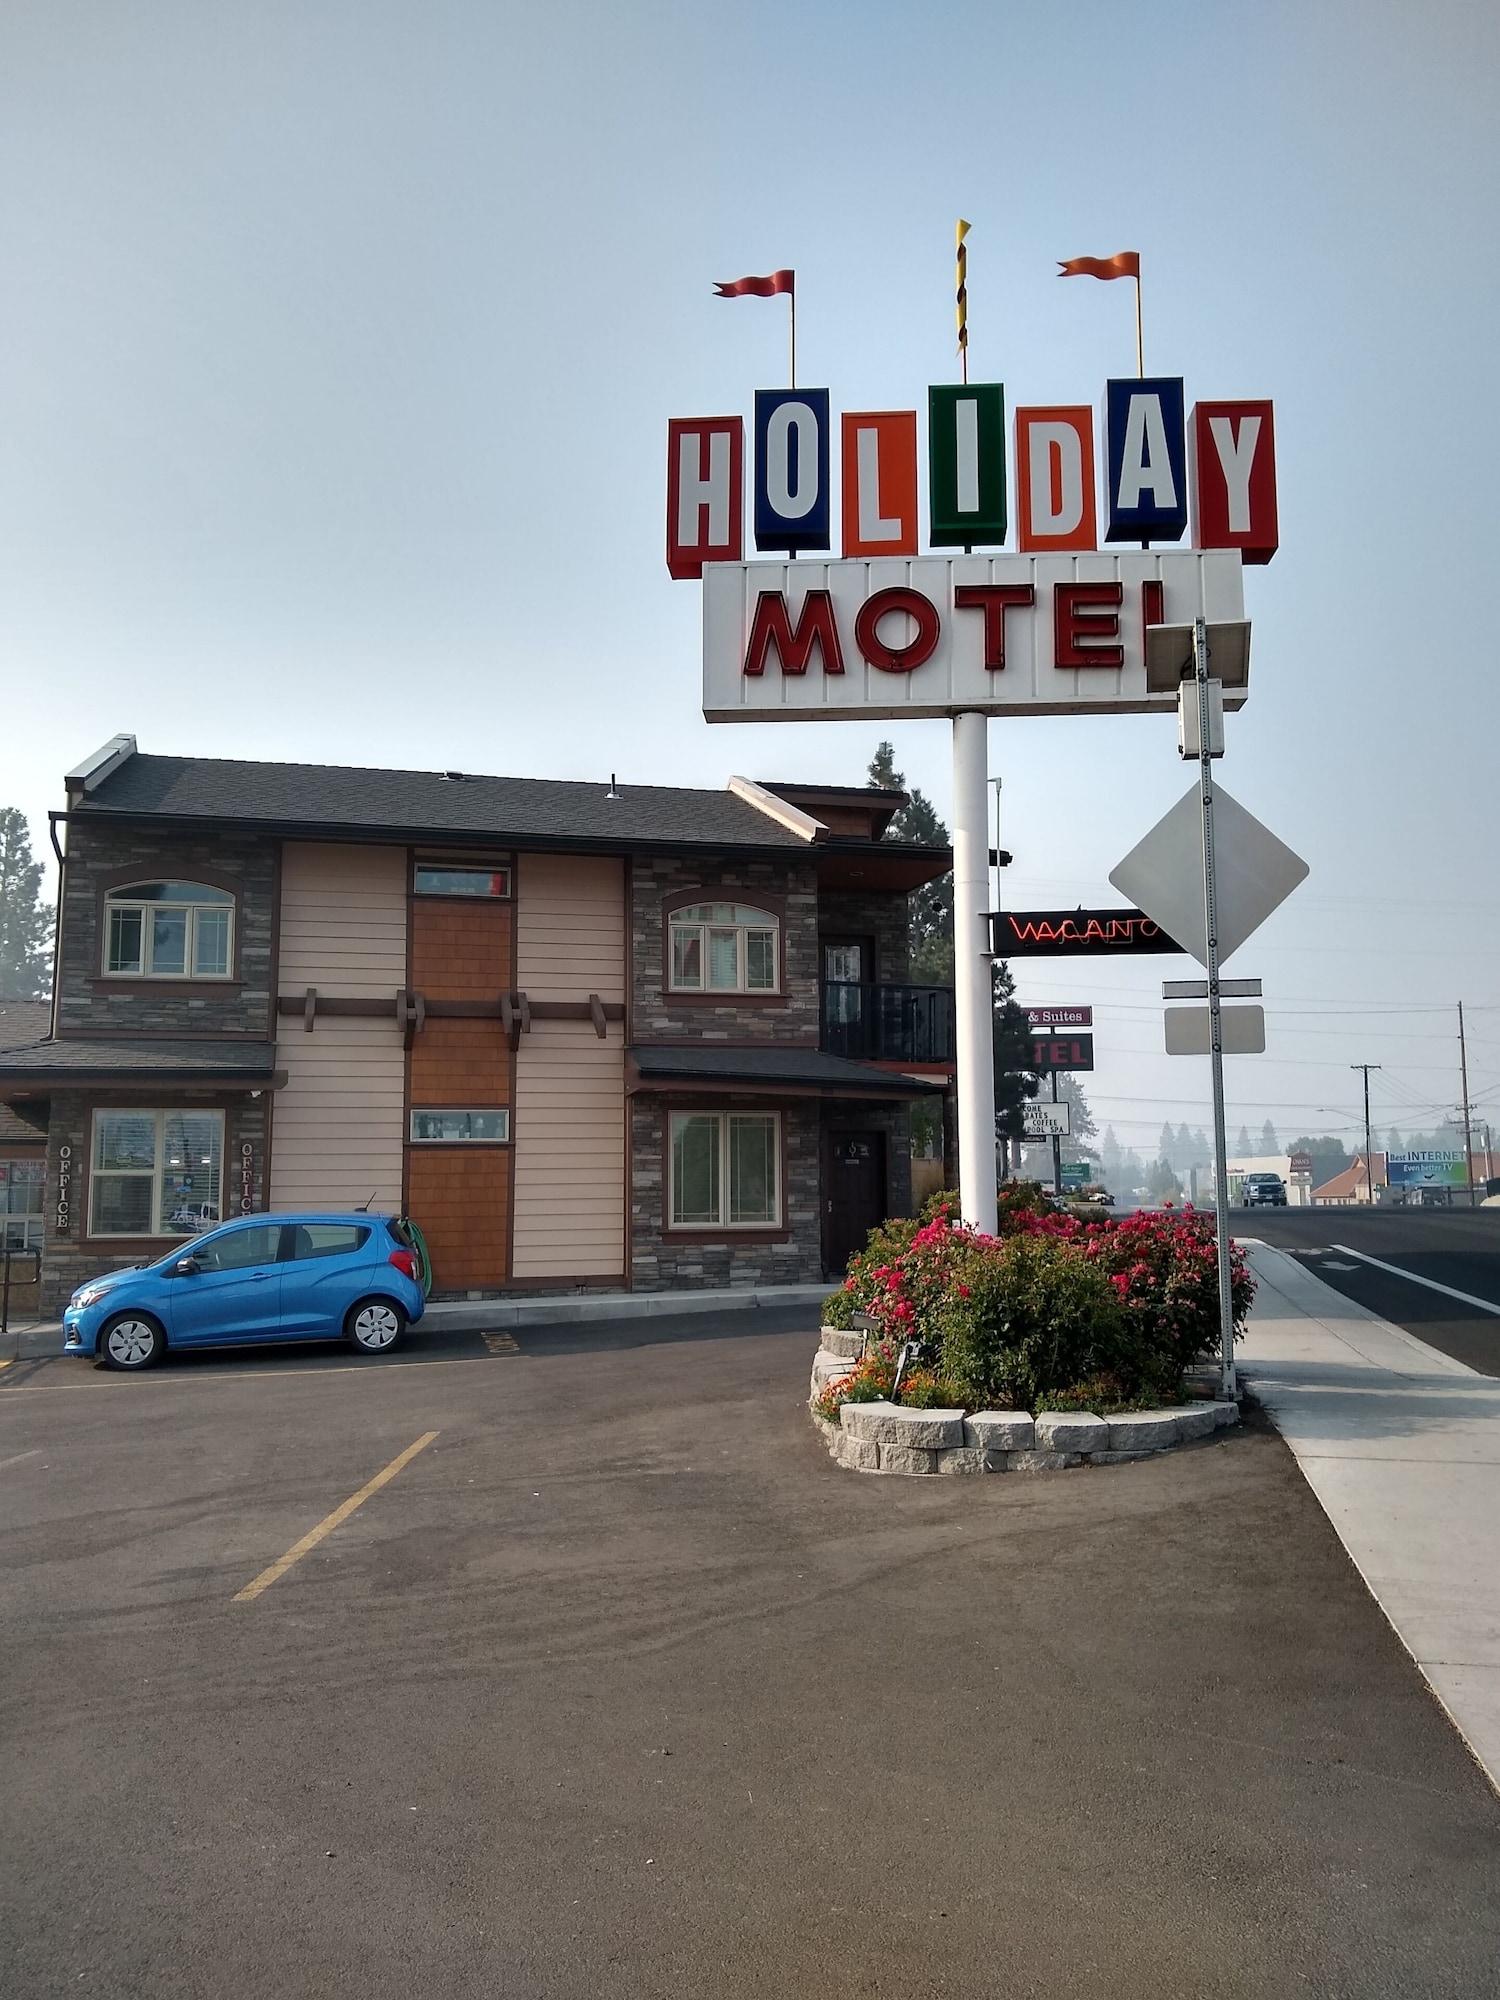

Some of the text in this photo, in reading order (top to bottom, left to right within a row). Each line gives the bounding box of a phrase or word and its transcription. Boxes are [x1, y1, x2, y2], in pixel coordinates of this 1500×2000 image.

[677, 393, 1263, 547] HOLIDAY
[1028, 1011, 1083, 1022] & Suites
[1390, 1151, 1466, 1161] Best INTERNET
[1403, 1164, 1420, 1172] Even
[56, 1145, 71, 1229] OFFICE
[240, 1143, 253, 1216] OFFIC
